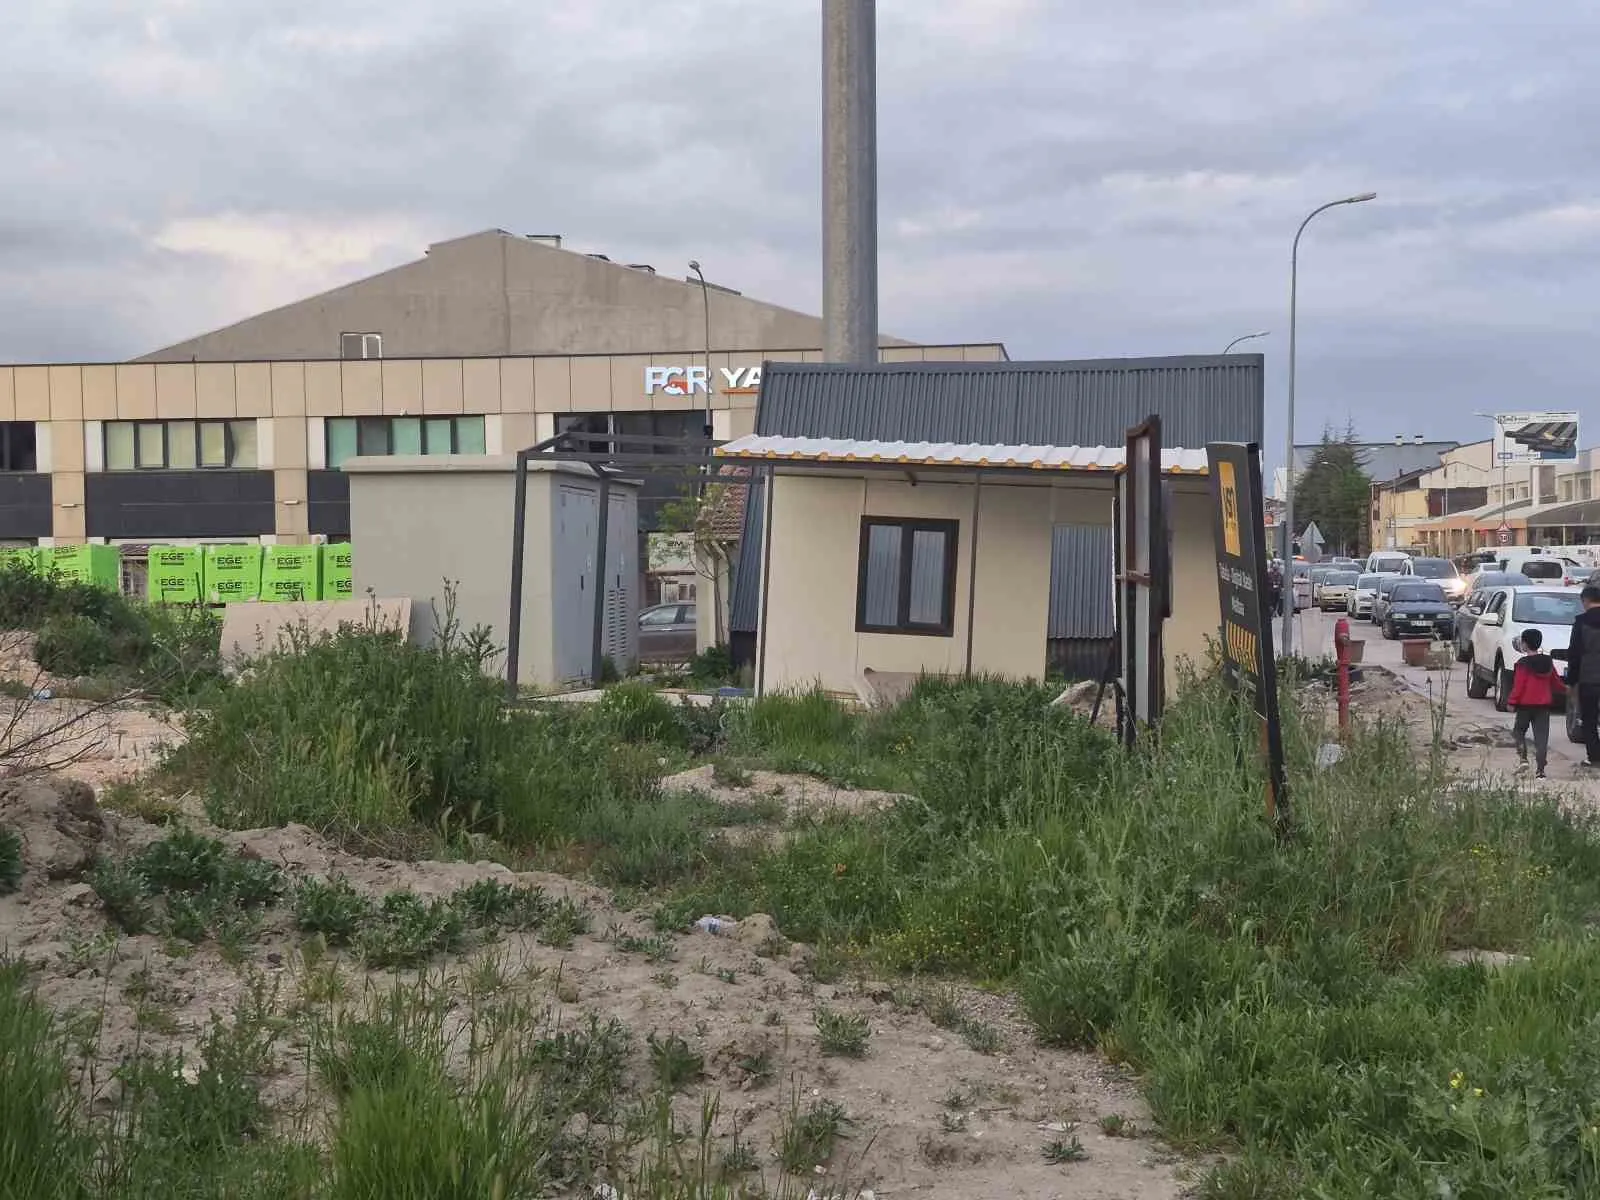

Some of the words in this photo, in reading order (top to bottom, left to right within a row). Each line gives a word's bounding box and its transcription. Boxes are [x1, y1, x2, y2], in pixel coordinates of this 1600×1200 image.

[720, 367, 761, 388] YA
[160, 552, 185, 561] EGE
[217, 556, 242, 565] EGE
[335, 555, 352, 563] EG
[277, 557, 303, 565] EGE
[160, 578, 185, 586] EGE
[217, 582, 242, 590] EGE
[275, 582, 302, 590] EGE
[336, 580, 352, 588] EG
